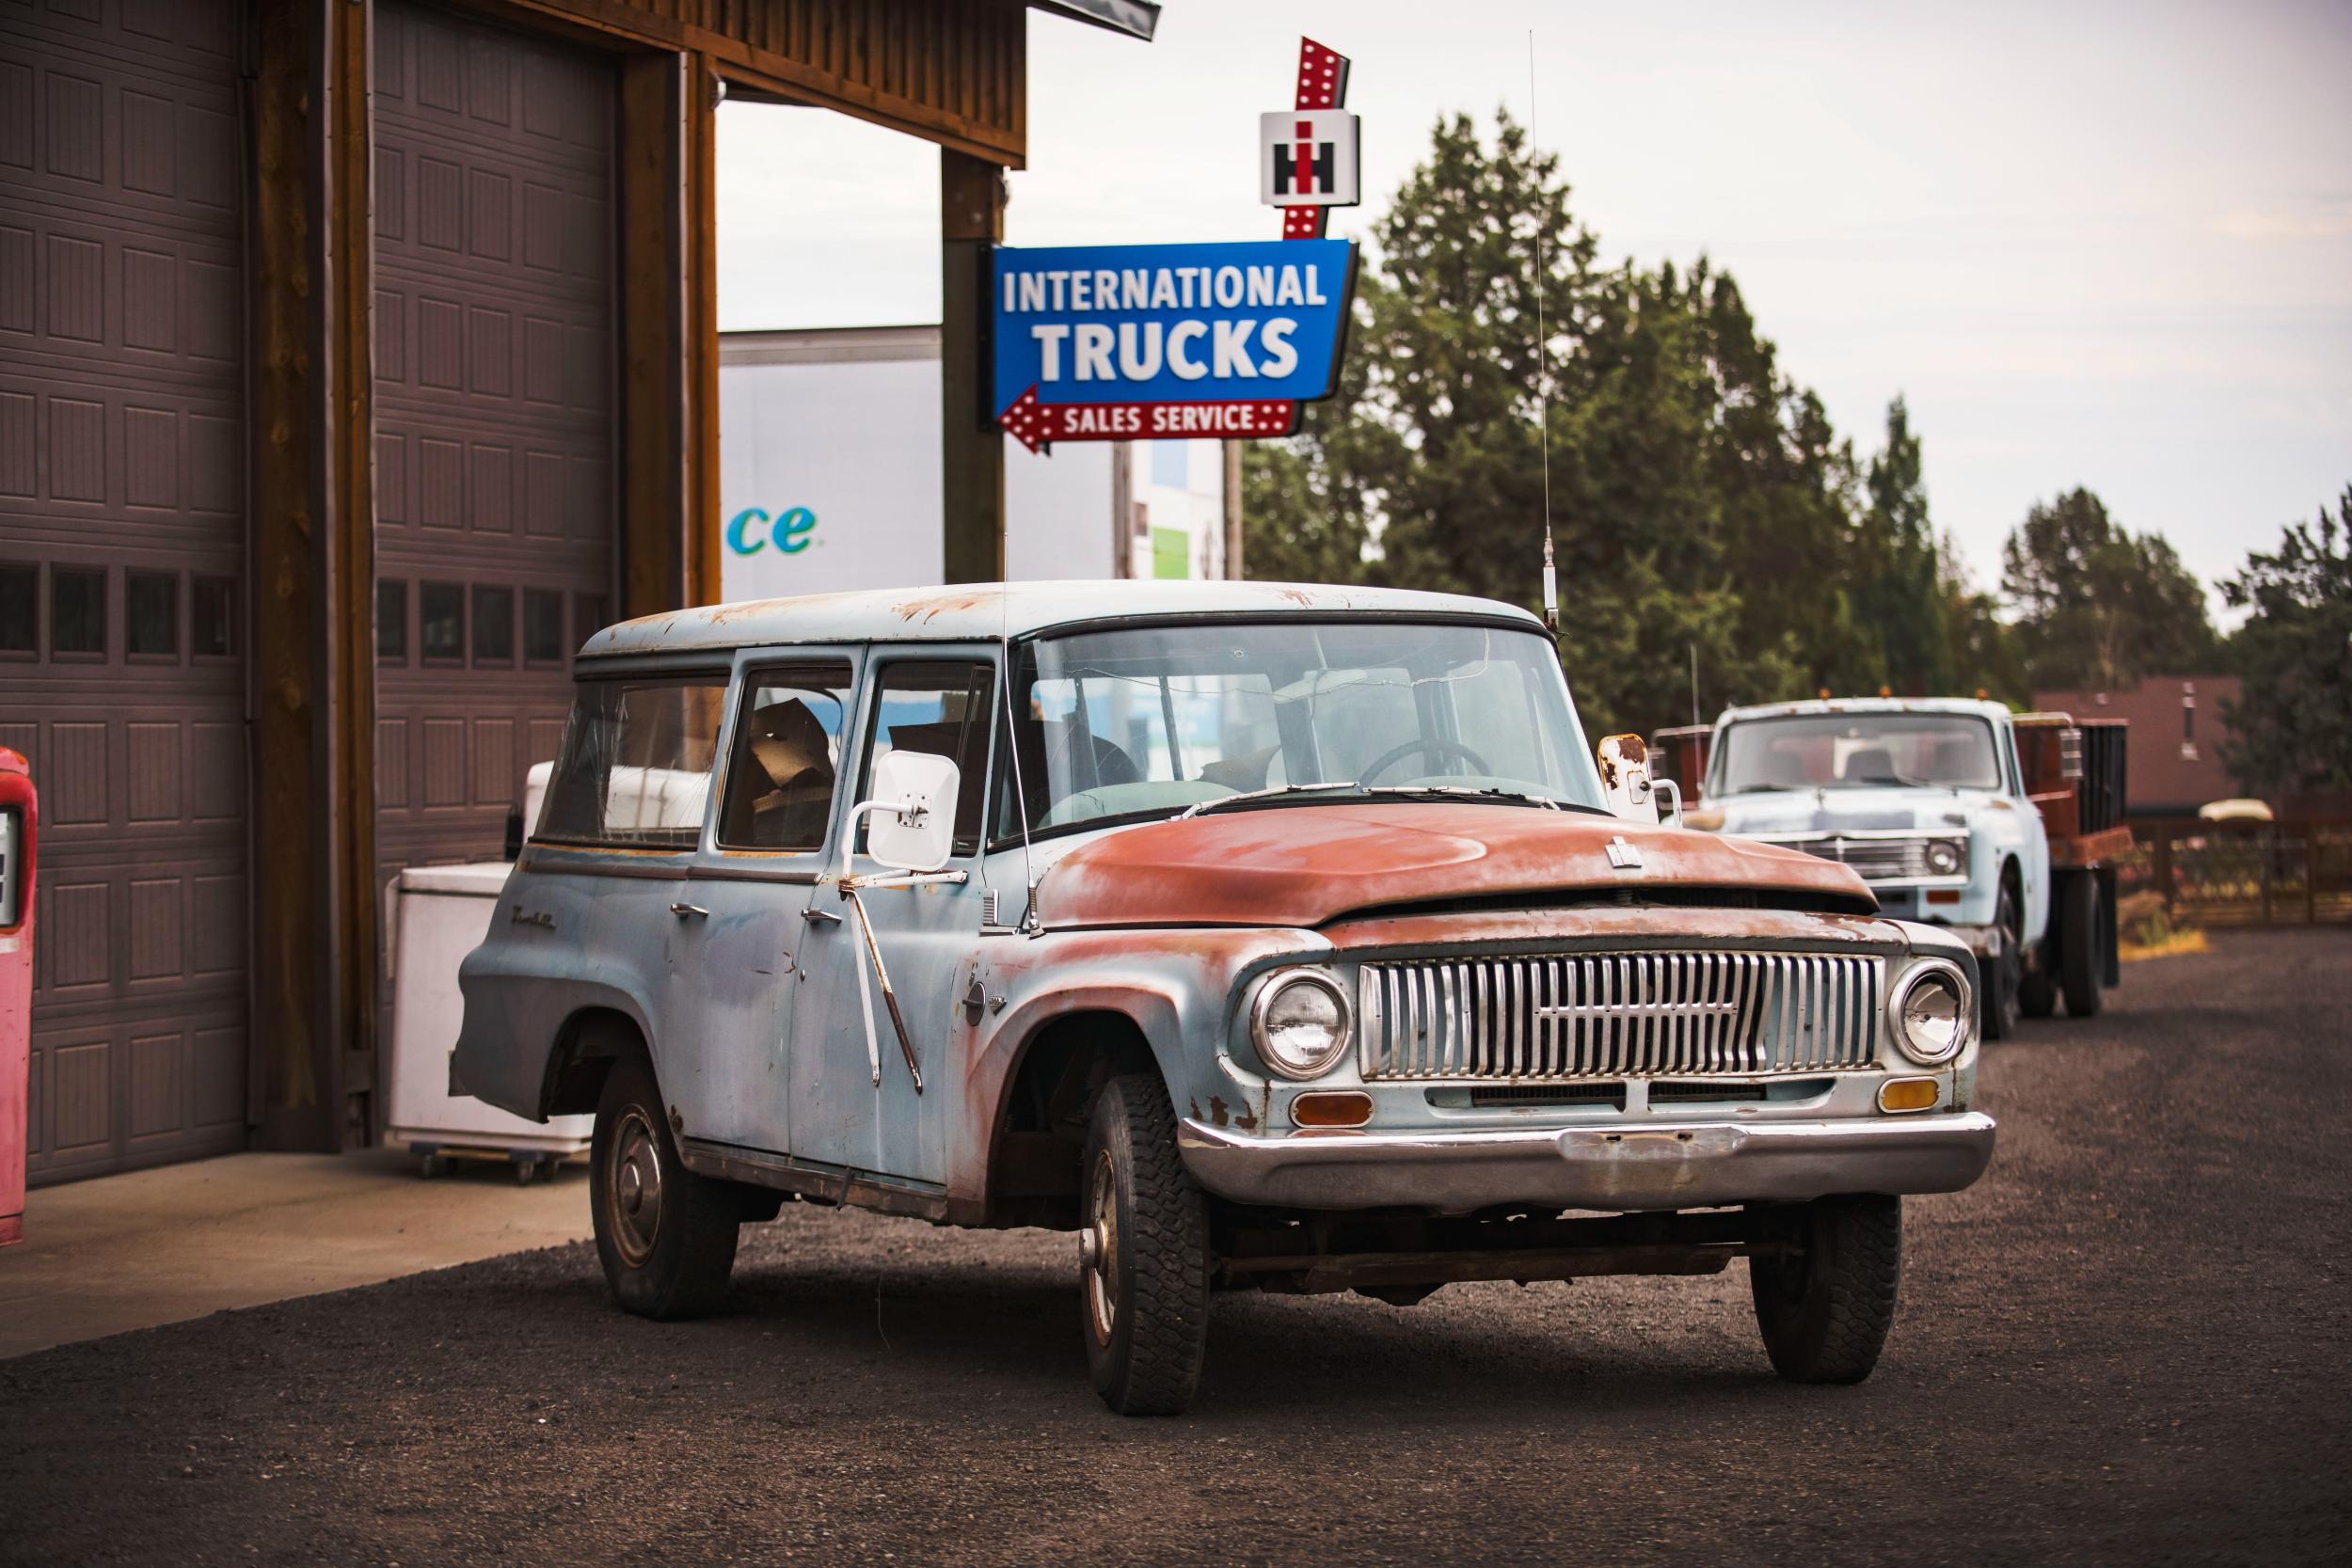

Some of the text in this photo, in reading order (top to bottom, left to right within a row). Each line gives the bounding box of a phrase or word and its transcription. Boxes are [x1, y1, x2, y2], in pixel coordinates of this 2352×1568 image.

[1003, 264, 1327, 312] INTERNATIONAL
[1031, 317, 1299, 382] TRUCKS
[1063, 404, 1254, 433] SALES SERVICE
